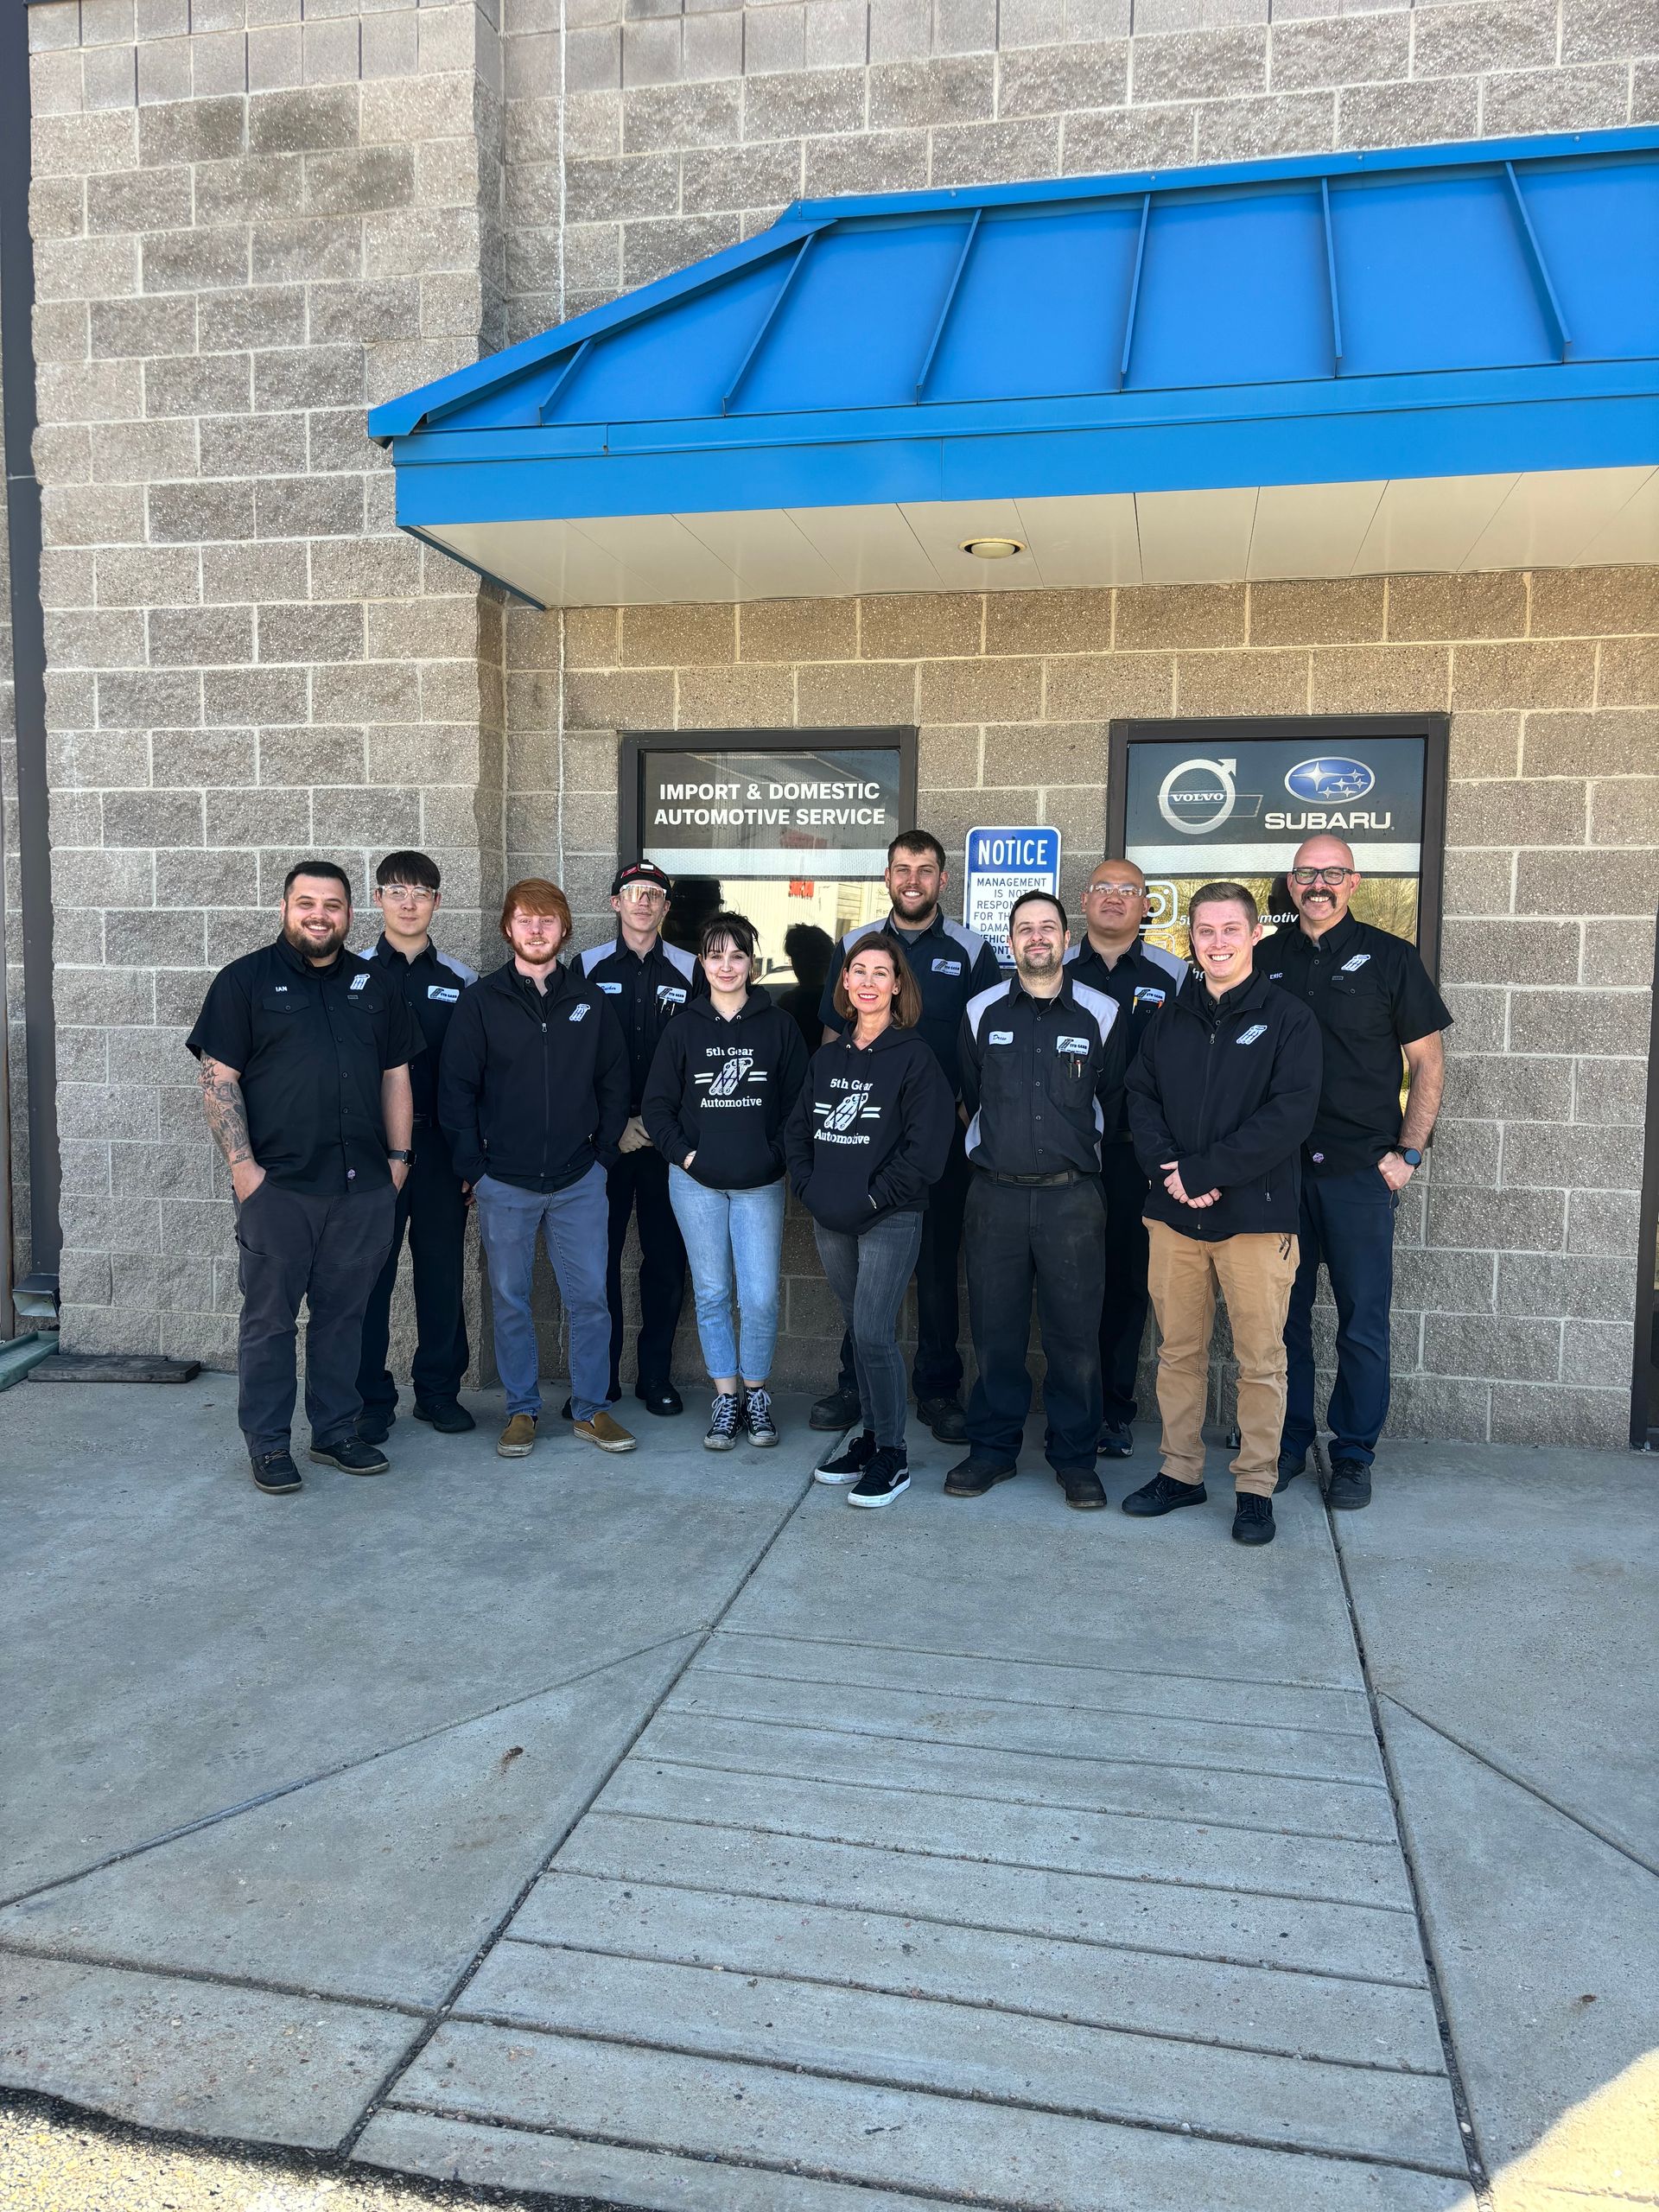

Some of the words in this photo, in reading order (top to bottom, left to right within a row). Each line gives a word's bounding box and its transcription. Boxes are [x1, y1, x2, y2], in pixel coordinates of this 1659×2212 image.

[660, 783, 741, 800] IMPORT
[747, 783, 762, 800] &
[769, 782, 880, 800] DOMESTIC
[1171, 792, 1224, 802] VOLVO
[654, 809, 790, 825] AUTOMOTIVE
[796, 808, 886, 825] SERVICE
[1264, 811, 1391, 830] SUBARU
[978, 839, 1048, 865] NOTICE
[976, 877, 1046, 887] MANAGEMENT
[994, 889, 1003, 898] IS
[1008, 888, 1027, 898] NOT
[977, 900, 1014, 909] RESPON
[974, 912, 993, 920] FOR
[981, 923, 1008, 932] DAMA
[706, 1046, 725, 1057] 5th
[728, 1047, 753, 1056] Gear
[830, 1078, 849, 1090] 5th
[851, 1080, 873, 1090] Gear
[700, 1096, 762, 1108] Automotive
[813, 1128, 870, 1144] Automotive
